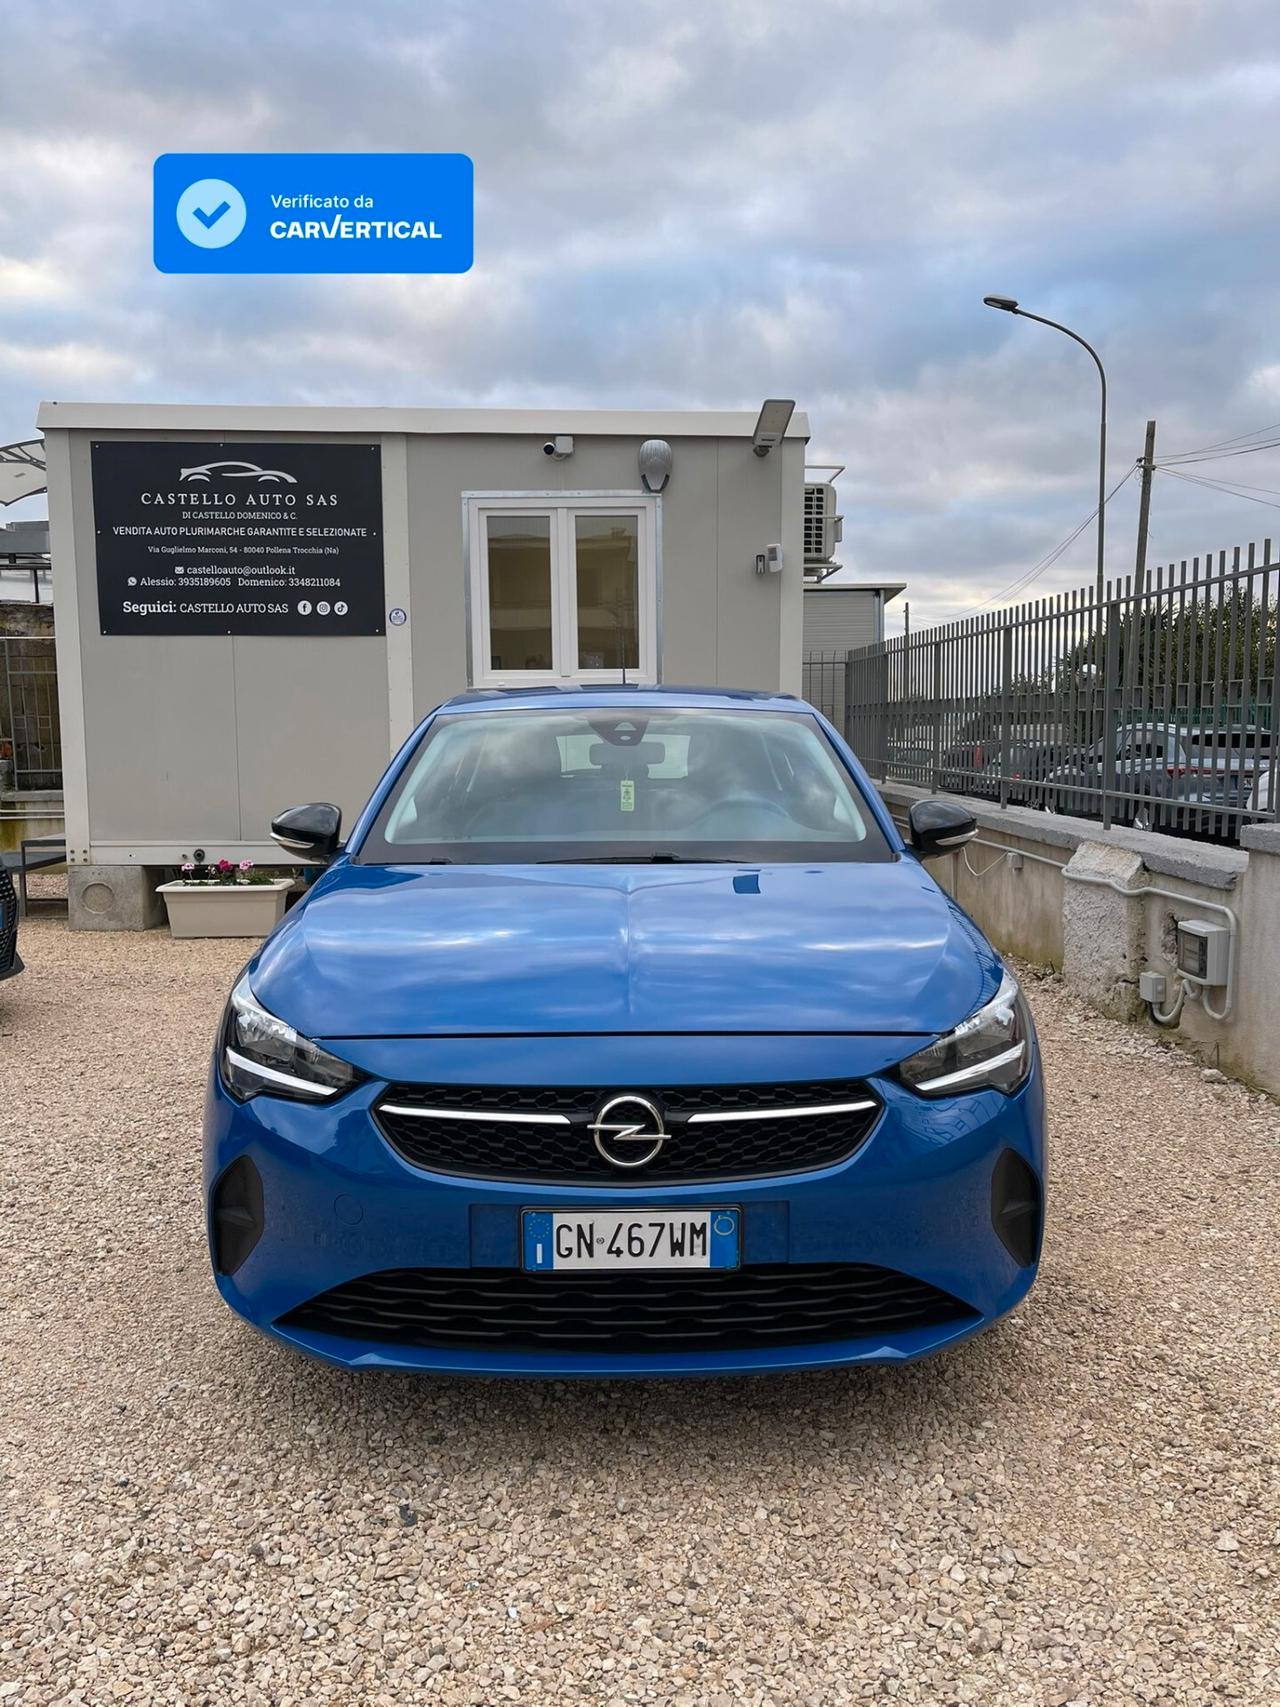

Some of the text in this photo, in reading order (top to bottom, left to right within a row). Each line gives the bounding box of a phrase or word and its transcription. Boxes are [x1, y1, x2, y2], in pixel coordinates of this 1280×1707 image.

[141, 493, 338, 506] CASTELLO AUTO SAS
[182, 511, 298, 520] DI CASTELLO DOMENICO & C.
[112, 526, 367, 537] VENDITA AUTO PLURIMARCHE GARANTITE E SELEZIONATE
[147, 546, 160, 554] Via
[161, 546, 197, 555] Guglielmo
[197, 546, 229, 555] Marconi,
[265, 546, 291, 555] Pollena
[292, 547, 323, 555] Trocchia
[324, 546, 339, 556] (Na)
[187, 565, 296, 576] castelloauto@outlook.it
[140, 577, 341, 587] Alessio: 3935189605 Domenico: 3348211084
[122, 600, 289, 616] Seguici: CASTELLO AUTO SAS
